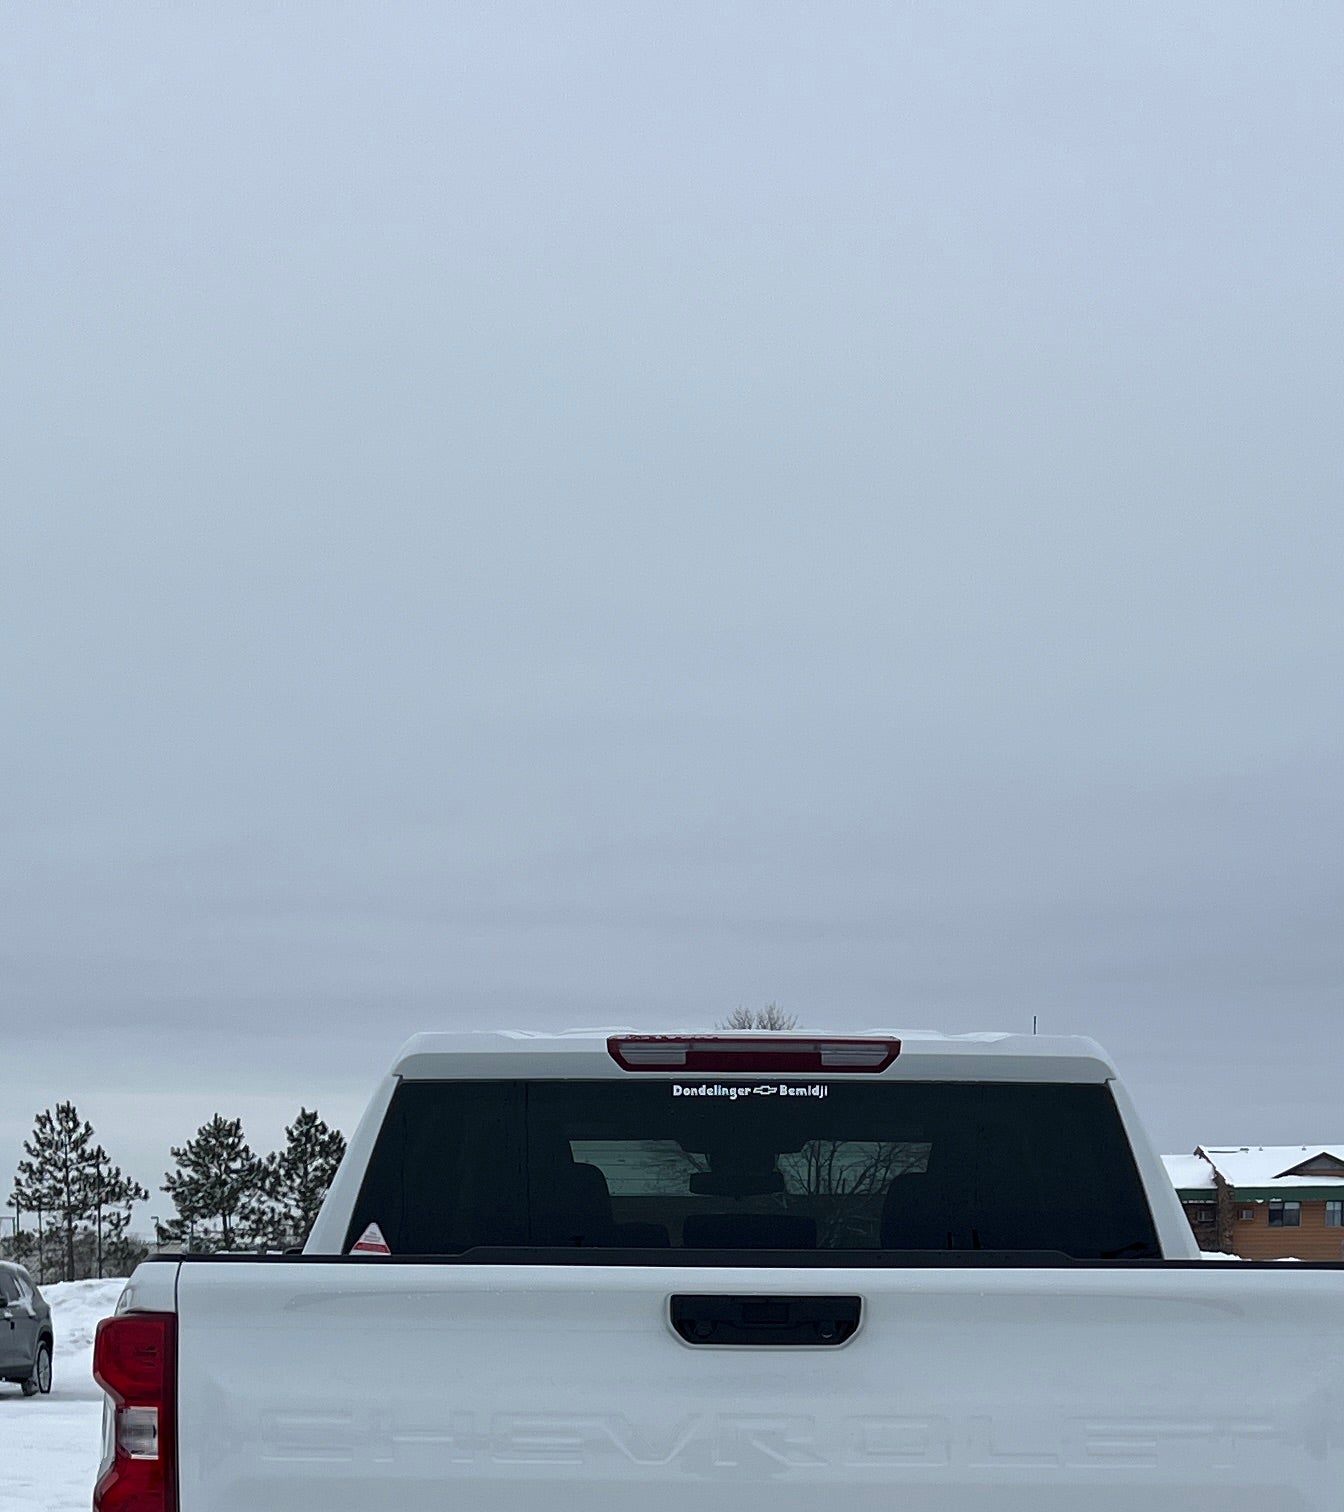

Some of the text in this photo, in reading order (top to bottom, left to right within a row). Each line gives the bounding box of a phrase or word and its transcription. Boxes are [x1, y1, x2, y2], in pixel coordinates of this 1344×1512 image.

[672, 1084, 828, 1100] Dondelinger Bemidji
[258, 1409, 1285, 1470] CHEVROLET
